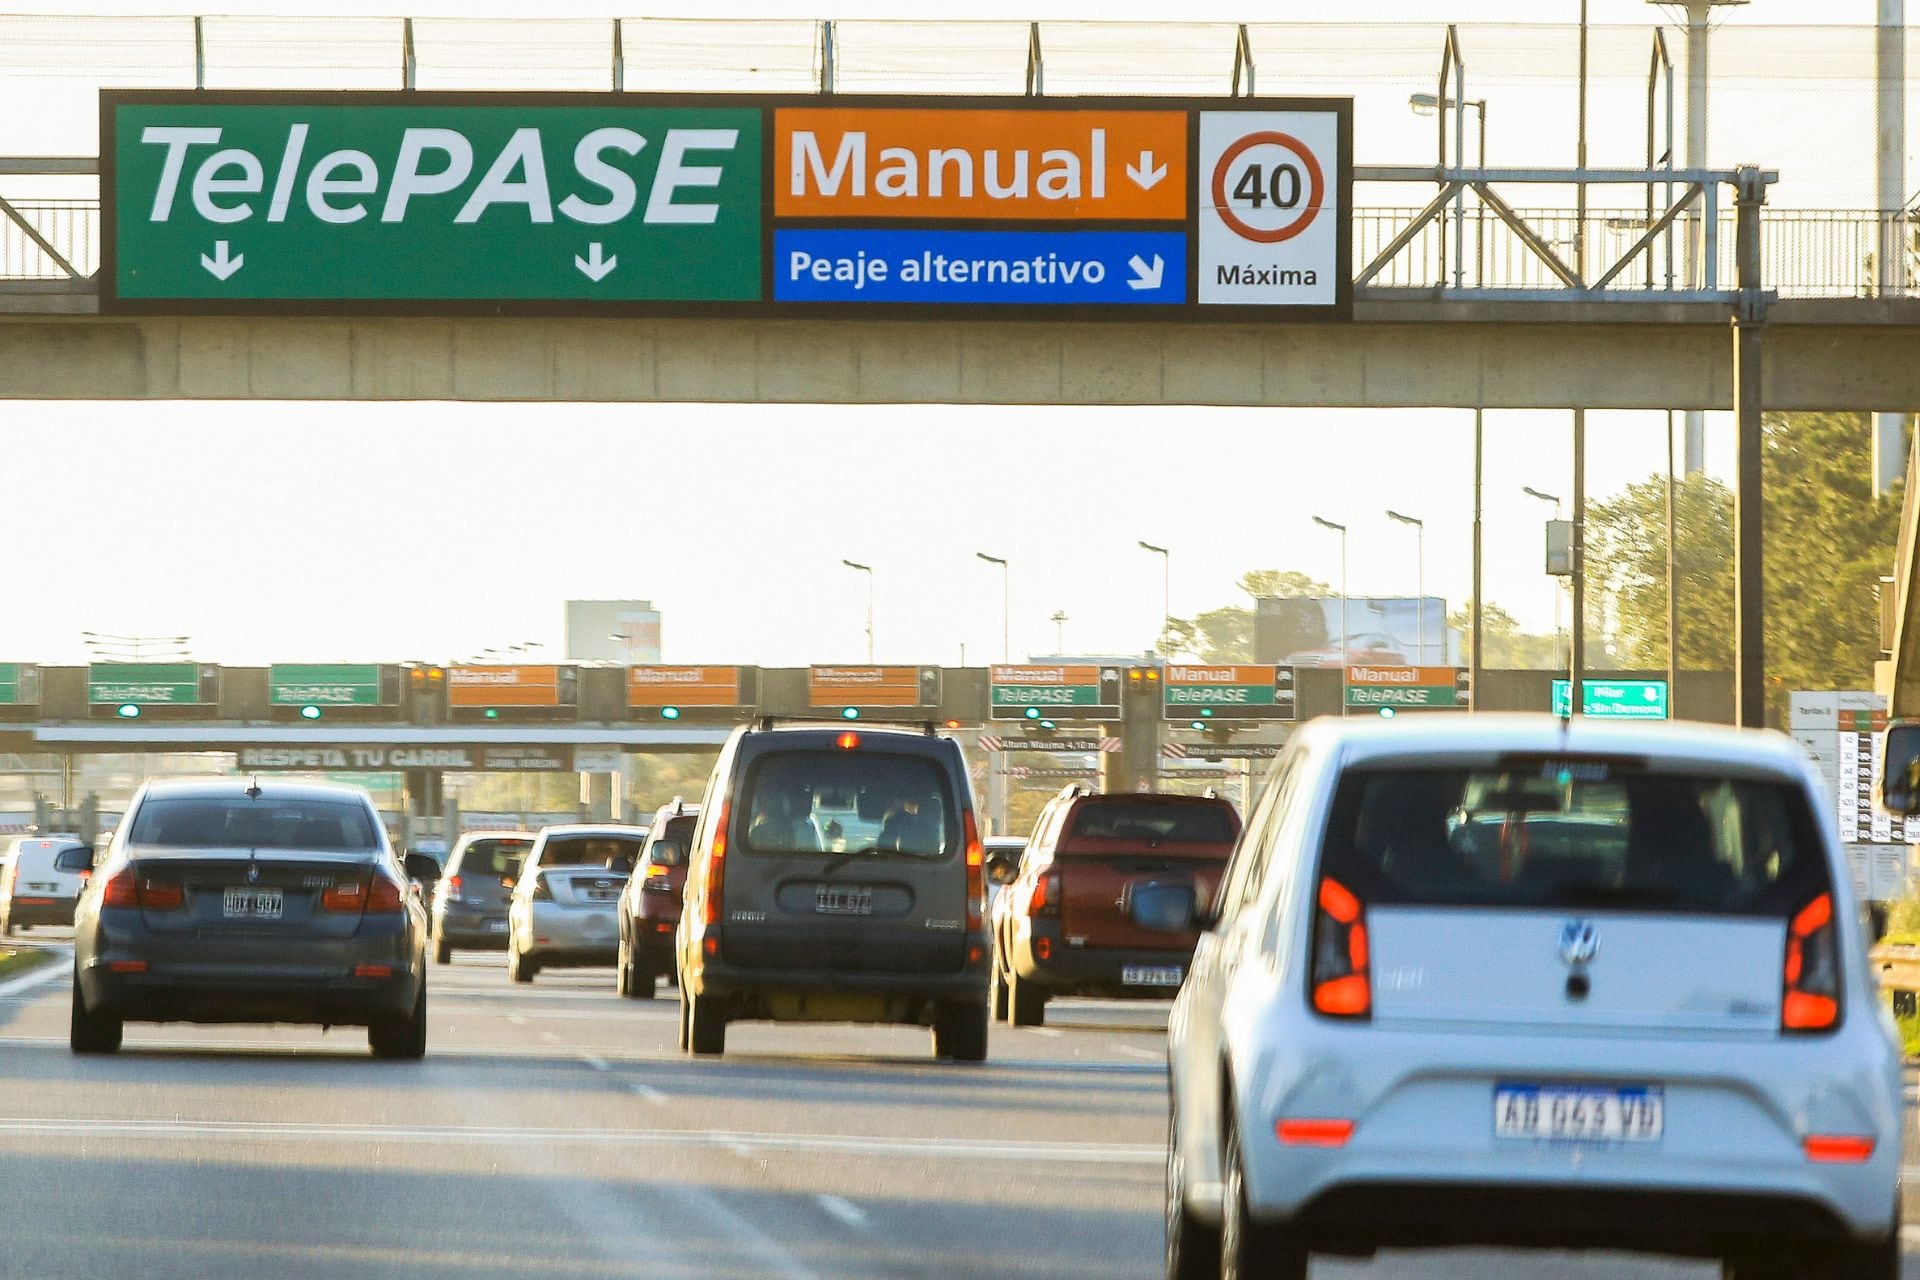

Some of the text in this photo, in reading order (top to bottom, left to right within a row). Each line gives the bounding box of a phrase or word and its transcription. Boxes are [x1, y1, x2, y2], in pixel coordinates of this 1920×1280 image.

[789, 128, 1106, 199] Manual
[139, 123, 740, 225] TelePASE
[1232, 162, 1299, 209] 40
[790, 250, 1106, 289] Peaje alternativo
[1216, 264, 1318, 287] Máxima
[633, 666, 704, 683] Manual
[996, 666, 1064, 682] Manual
[1170, 665, 1237, 682] Manual
[1350, 665, 1419, 683] Manual
[94, 686, 174, 701] TelePASE
[276, 686, 356, 702] TelePASE
[999, 688, 1076, 703] TelePASE
[1170, 687, 1248, 703] TelePASE
[1350, 687, 1430, 704] TelePASE
[1002, 740, 1028, 750] Altura
[243, 748, 347, 767] RESPETA
[350, 750, 384, 768] TU
[388, 749, 473, 767] CARRIL
